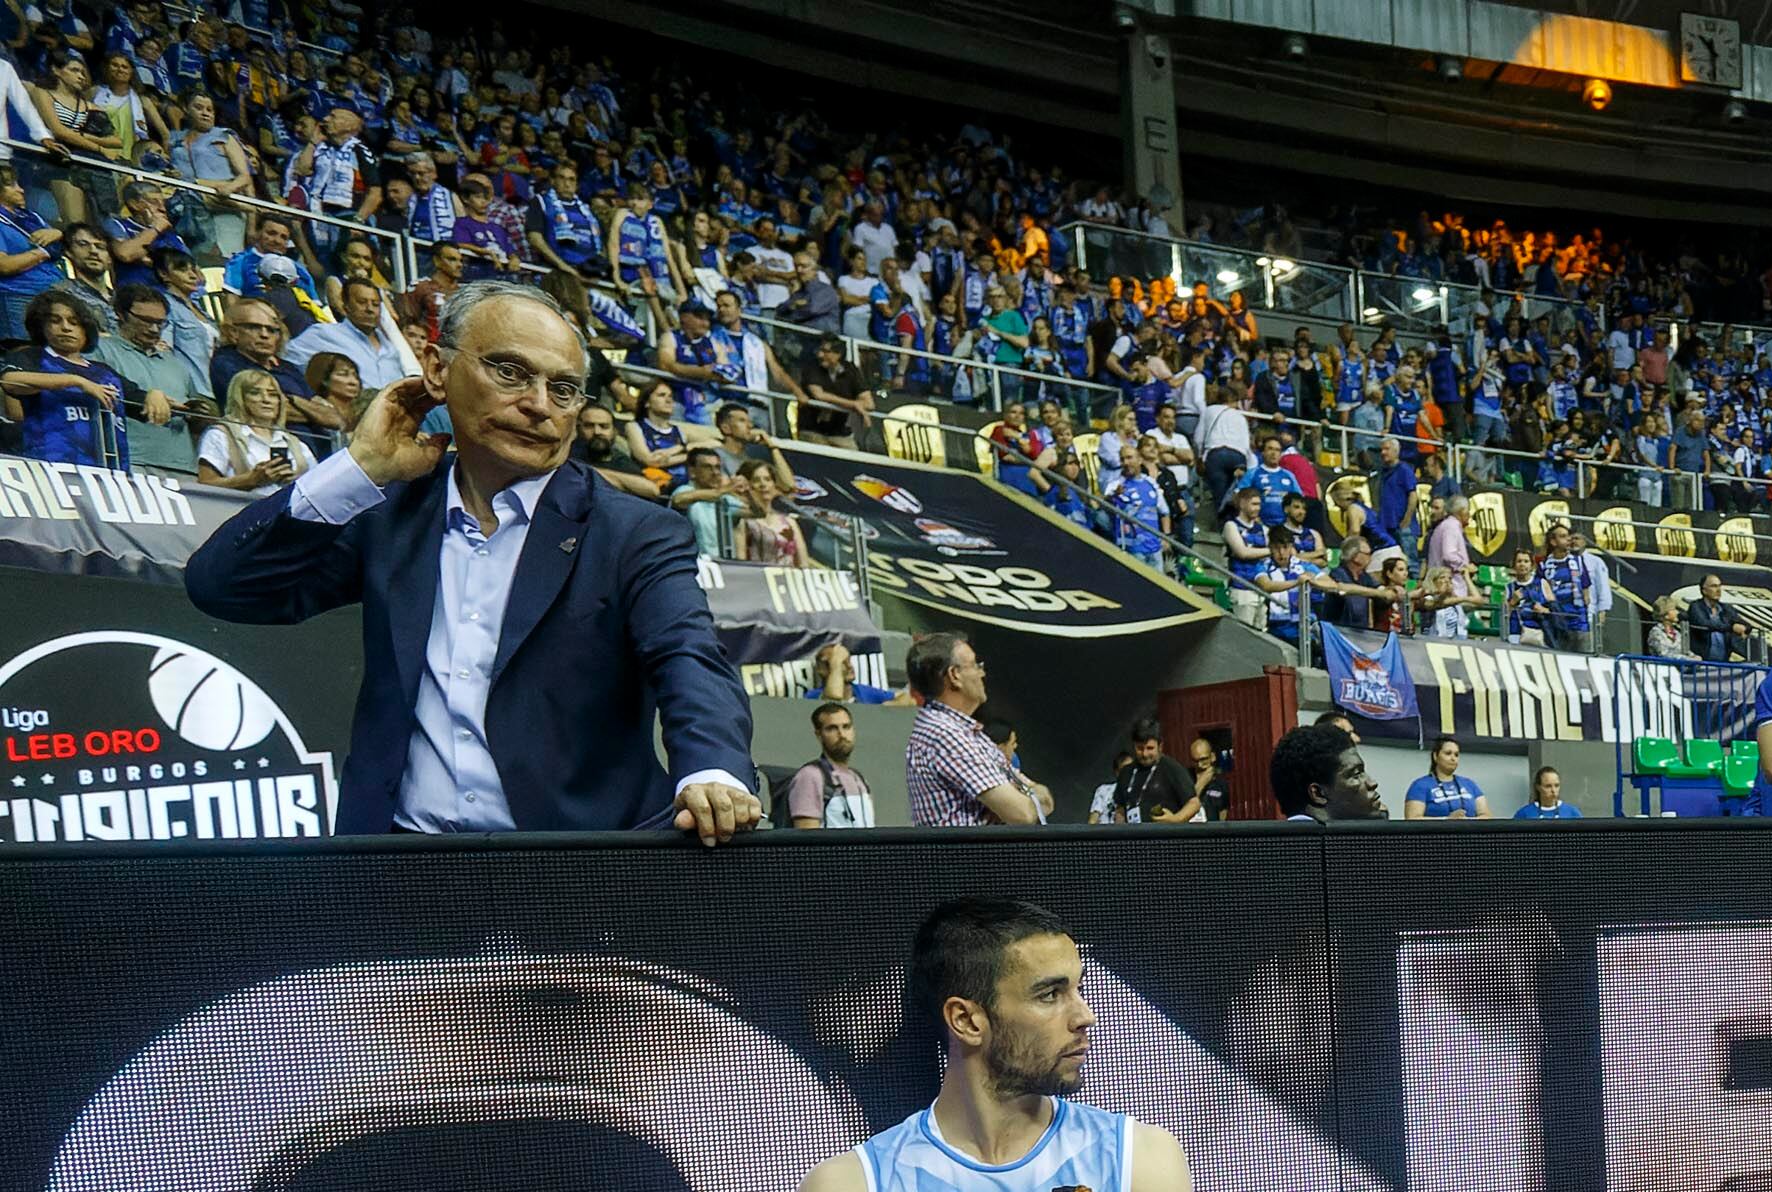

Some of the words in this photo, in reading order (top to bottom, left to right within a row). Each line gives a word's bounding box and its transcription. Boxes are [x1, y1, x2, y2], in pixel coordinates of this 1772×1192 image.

[2, 707, 50, 732] Liga
[6, 732, 77, 763] LEB
[84, 728, 161, 757] ORO
[77, 760, 209, 786] BURGOS
